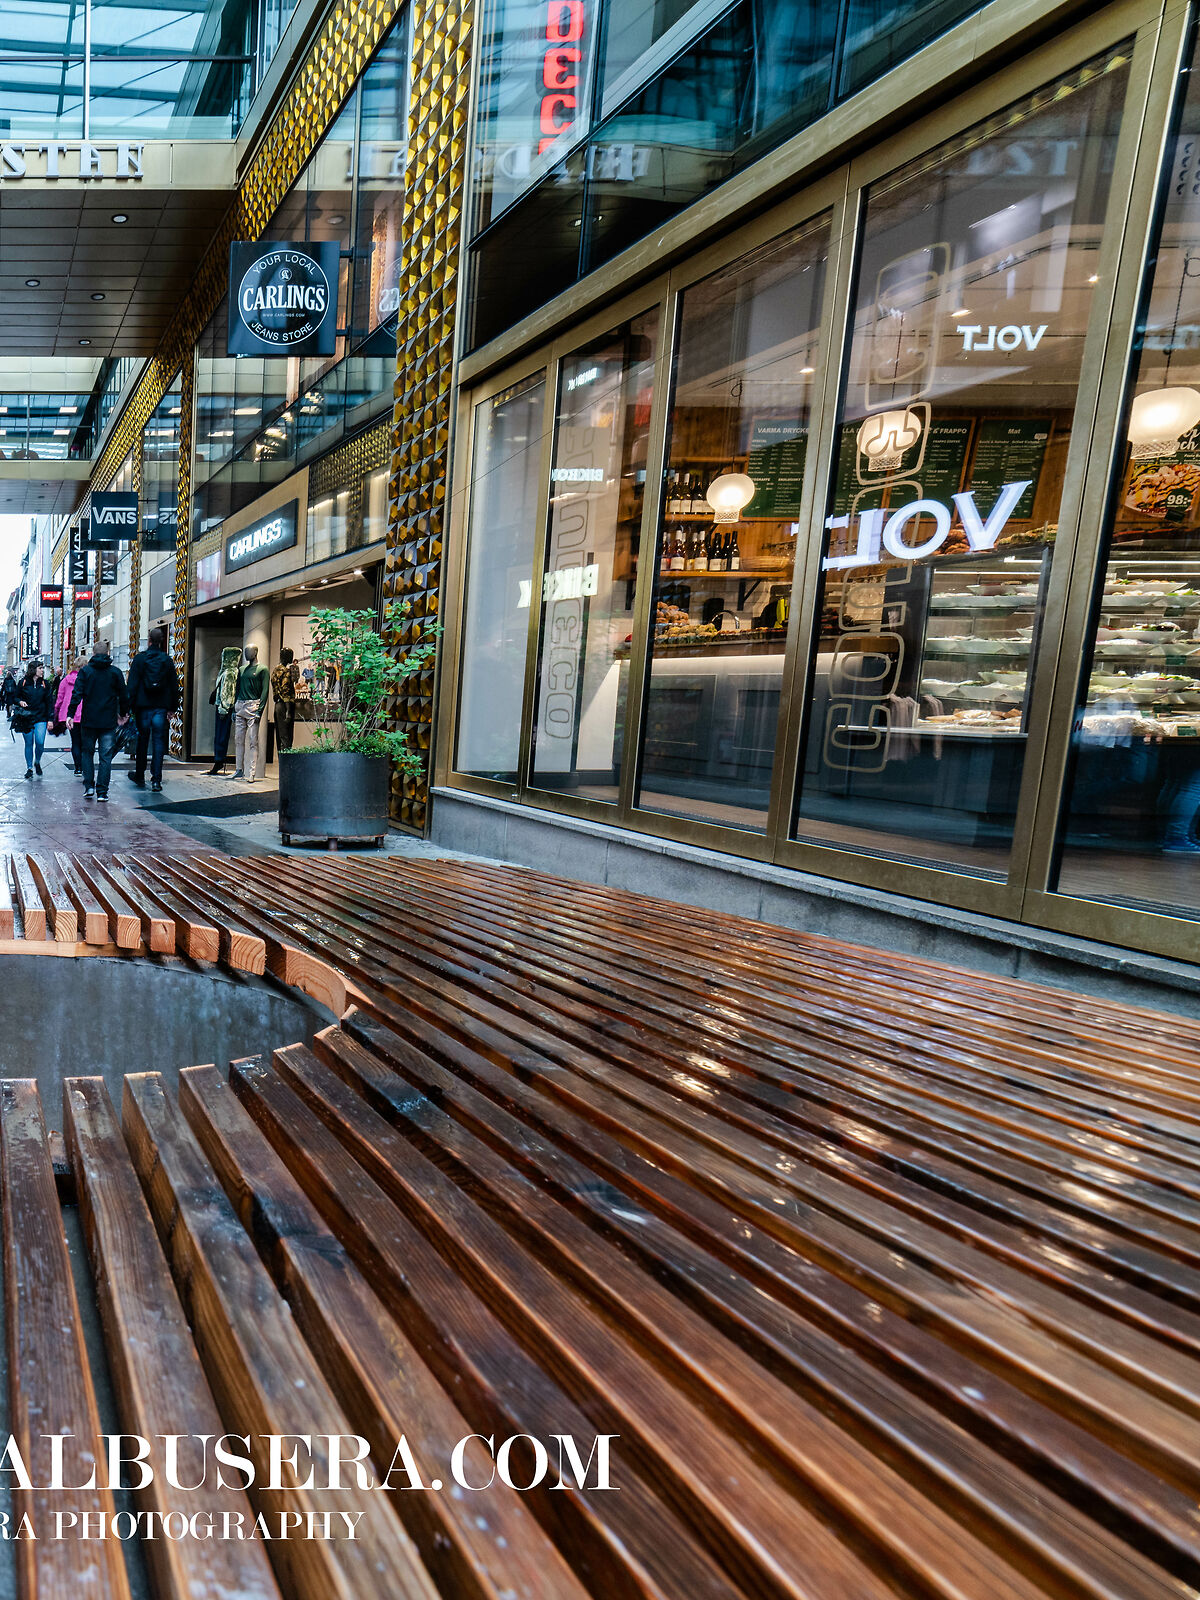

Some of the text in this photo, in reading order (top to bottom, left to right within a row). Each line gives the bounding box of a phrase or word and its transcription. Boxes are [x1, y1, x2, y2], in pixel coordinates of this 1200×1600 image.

[253, 254, 317, 275] YOUR LOCAL
[242, 284, 325, 312] CARLINGS
[251, 322, 313, 341] JEANS STORE
[92, 507, 137, 525] VANS
[229, 518, 283, 561] CARLINGS
